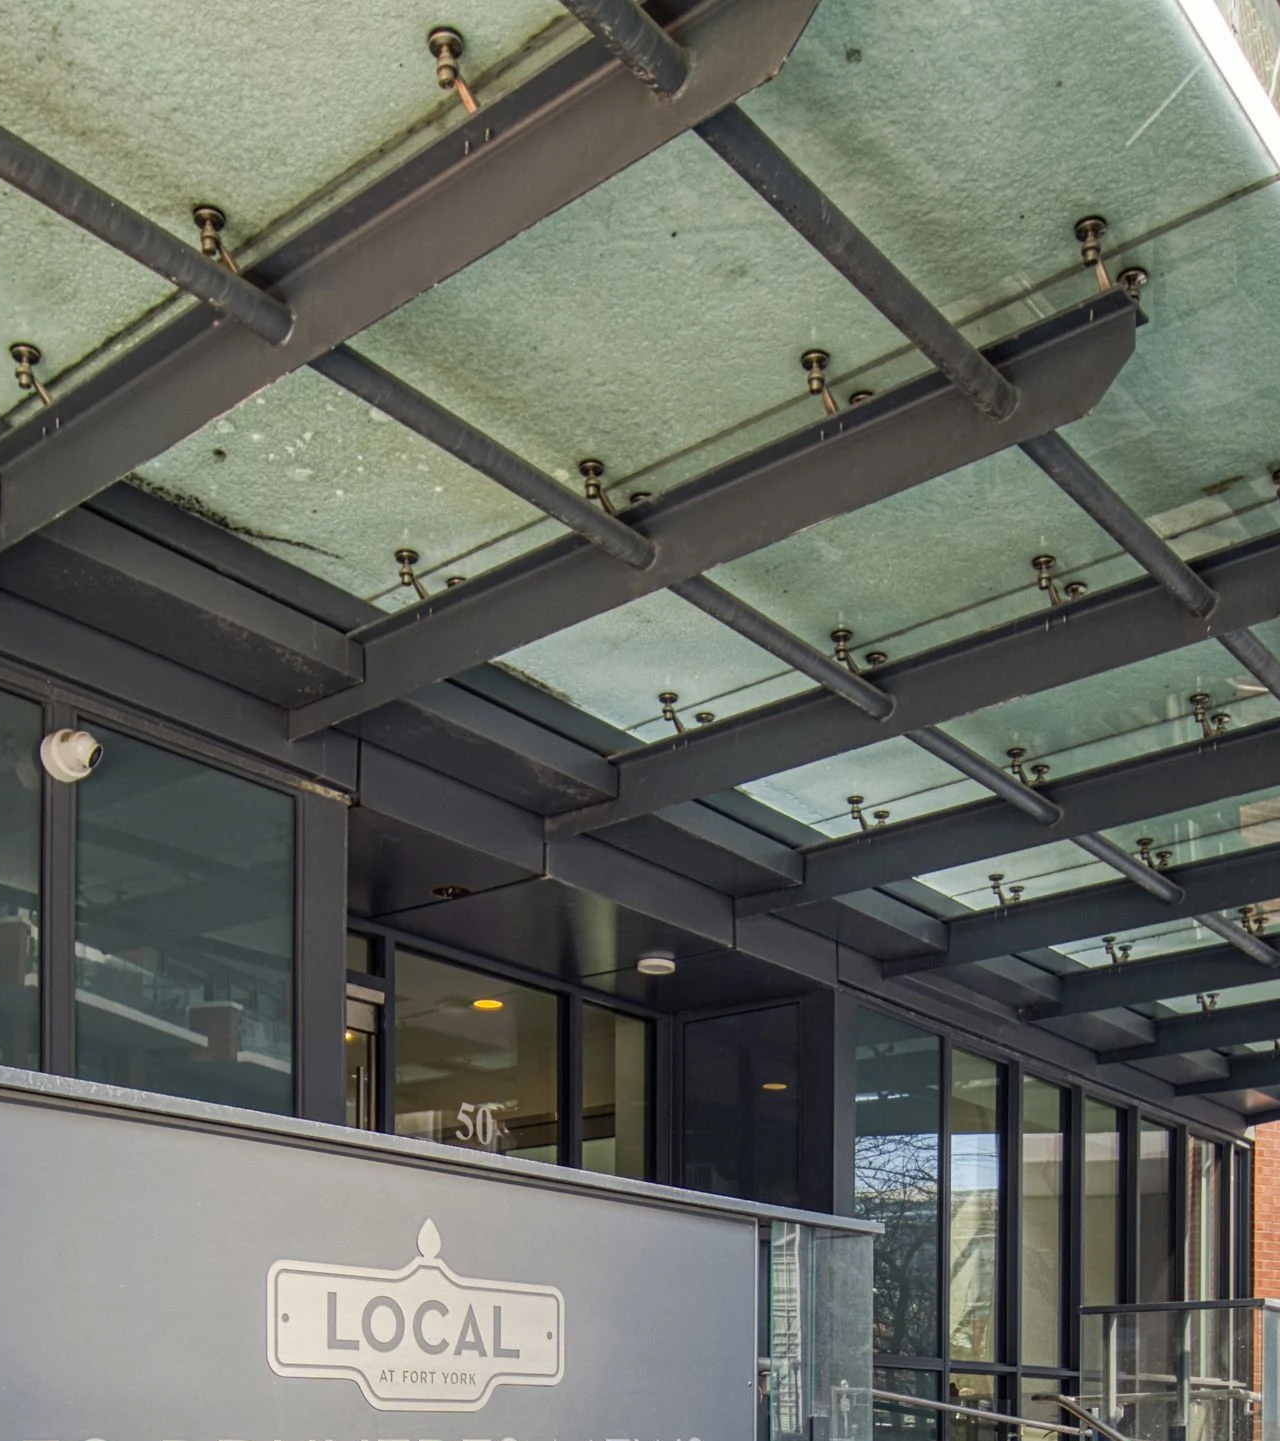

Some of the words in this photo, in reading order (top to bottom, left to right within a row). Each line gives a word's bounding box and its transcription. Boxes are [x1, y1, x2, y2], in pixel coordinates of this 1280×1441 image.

[455, 1102, 493, 1145] 50
[327, 1291, 520, 1359] LOCAL
[379, 1369, 395, 1383] AT
[402, 1370, 437, 1384] FORT
[442, 1372, 477, 1386] YORK
